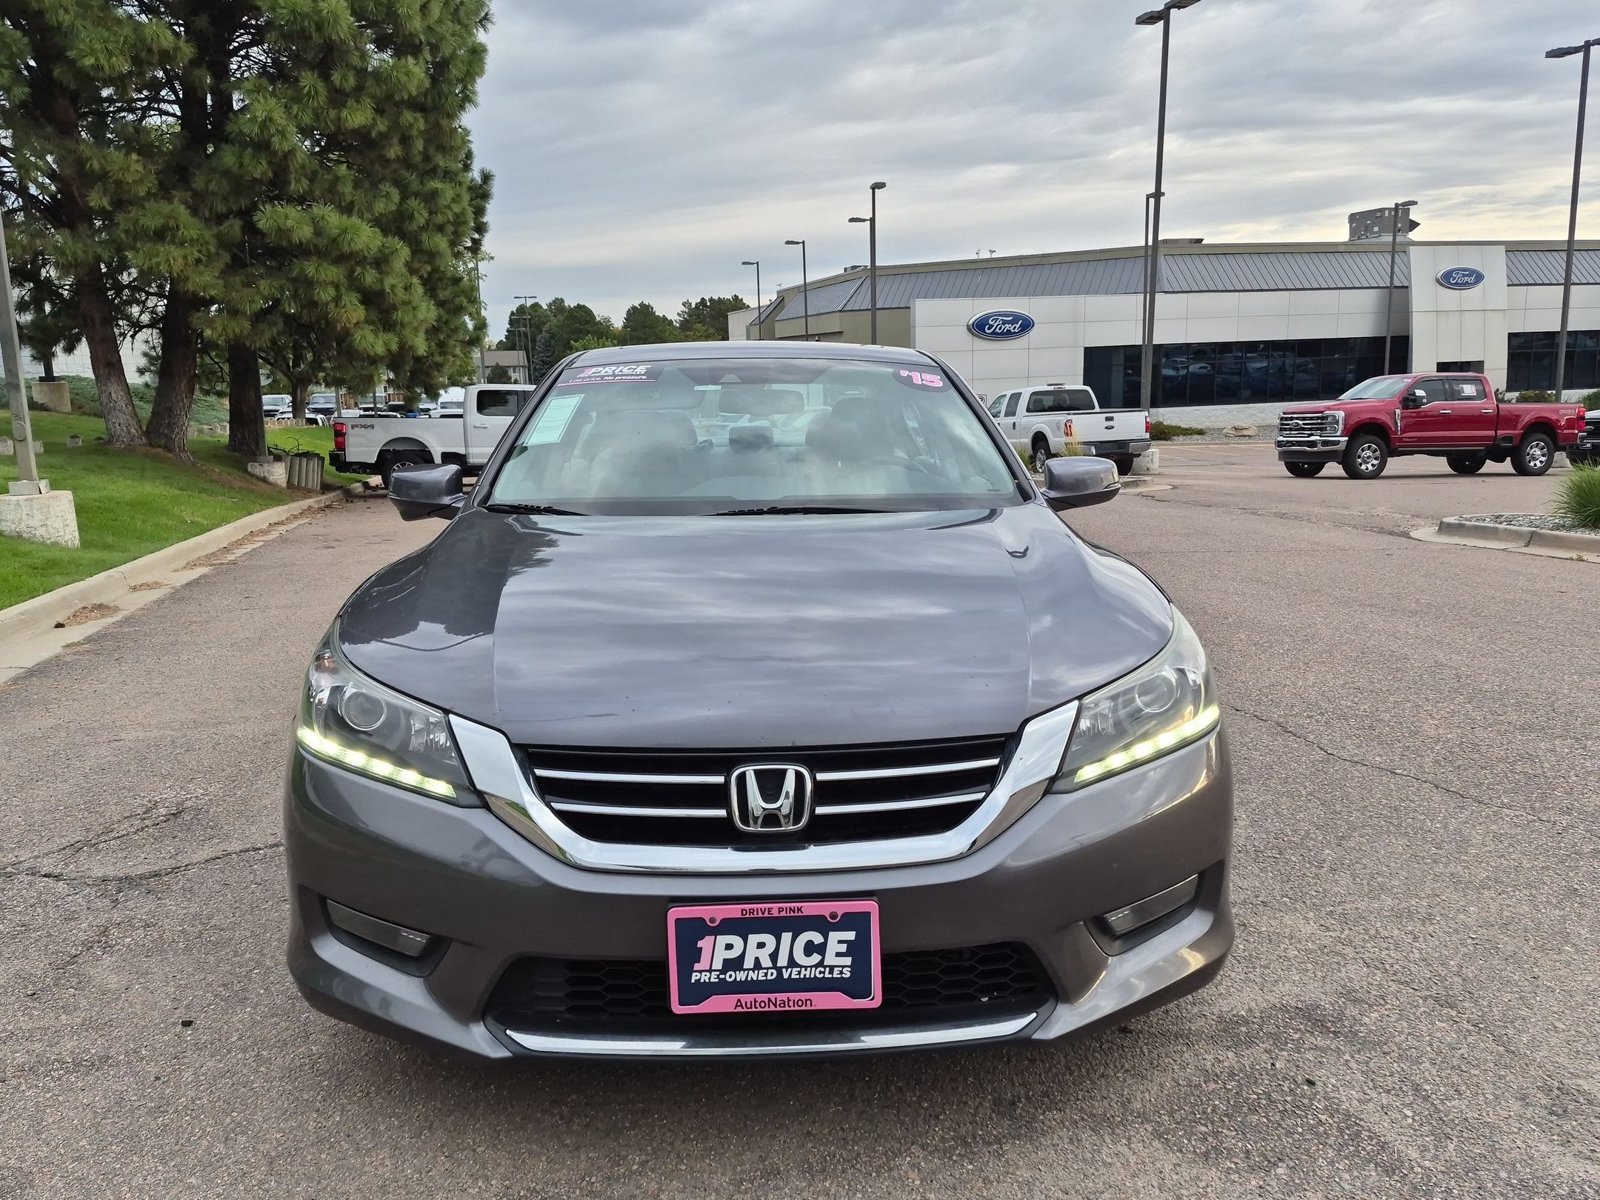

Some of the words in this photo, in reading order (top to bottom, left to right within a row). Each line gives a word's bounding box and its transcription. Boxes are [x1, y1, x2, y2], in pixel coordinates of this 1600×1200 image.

[1450, 271, 1476, 284] Ford
[984, 316, 1022, 334] Ford
[741, 907, 773, 917] DRIVE
[778, 905, 804, 915] PINK
[693, 931, 856, 970] 1PRICE
[691, 970, 777, 983] PRE-OWNED
[782, 967, 851, 979] VEHICLES
[734, 996, 814, 1010] AutoNation
